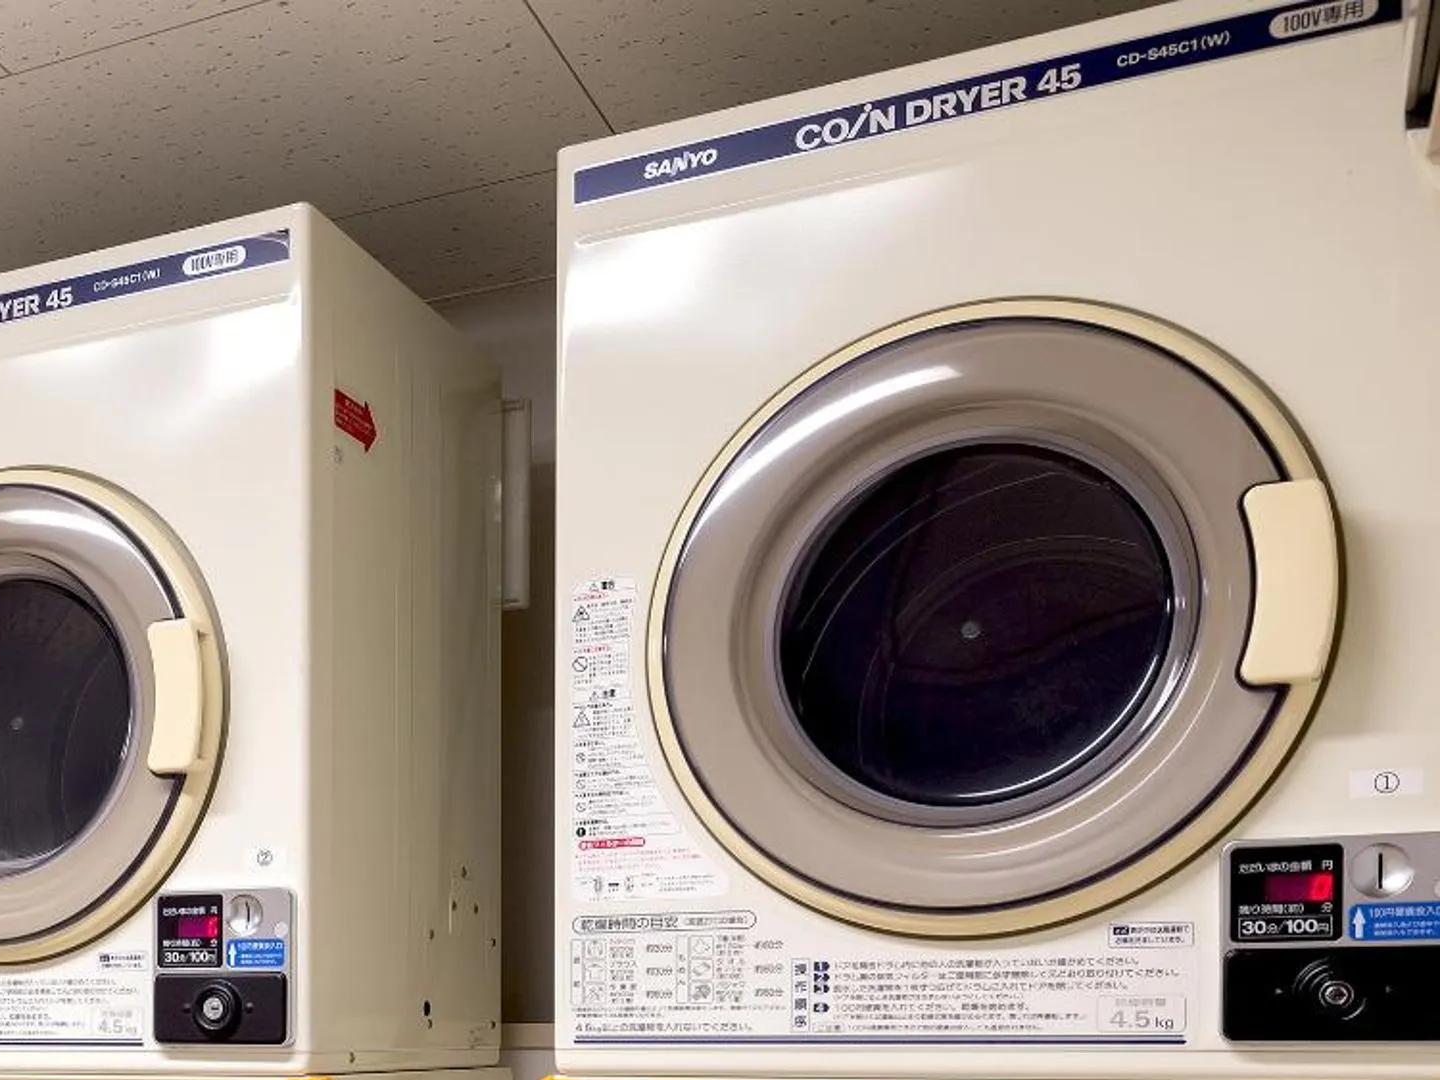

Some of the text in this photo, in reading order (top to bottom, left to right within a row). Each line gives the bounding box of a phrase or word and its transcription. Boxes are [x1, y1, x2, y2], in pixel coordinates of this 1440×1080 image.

[643, 149, 718, 179] SANYO
[905, 75, 1028, 126] DRYER
[1036, 62, 1082, 94] 45
[45, 286, 74, 311] 45
